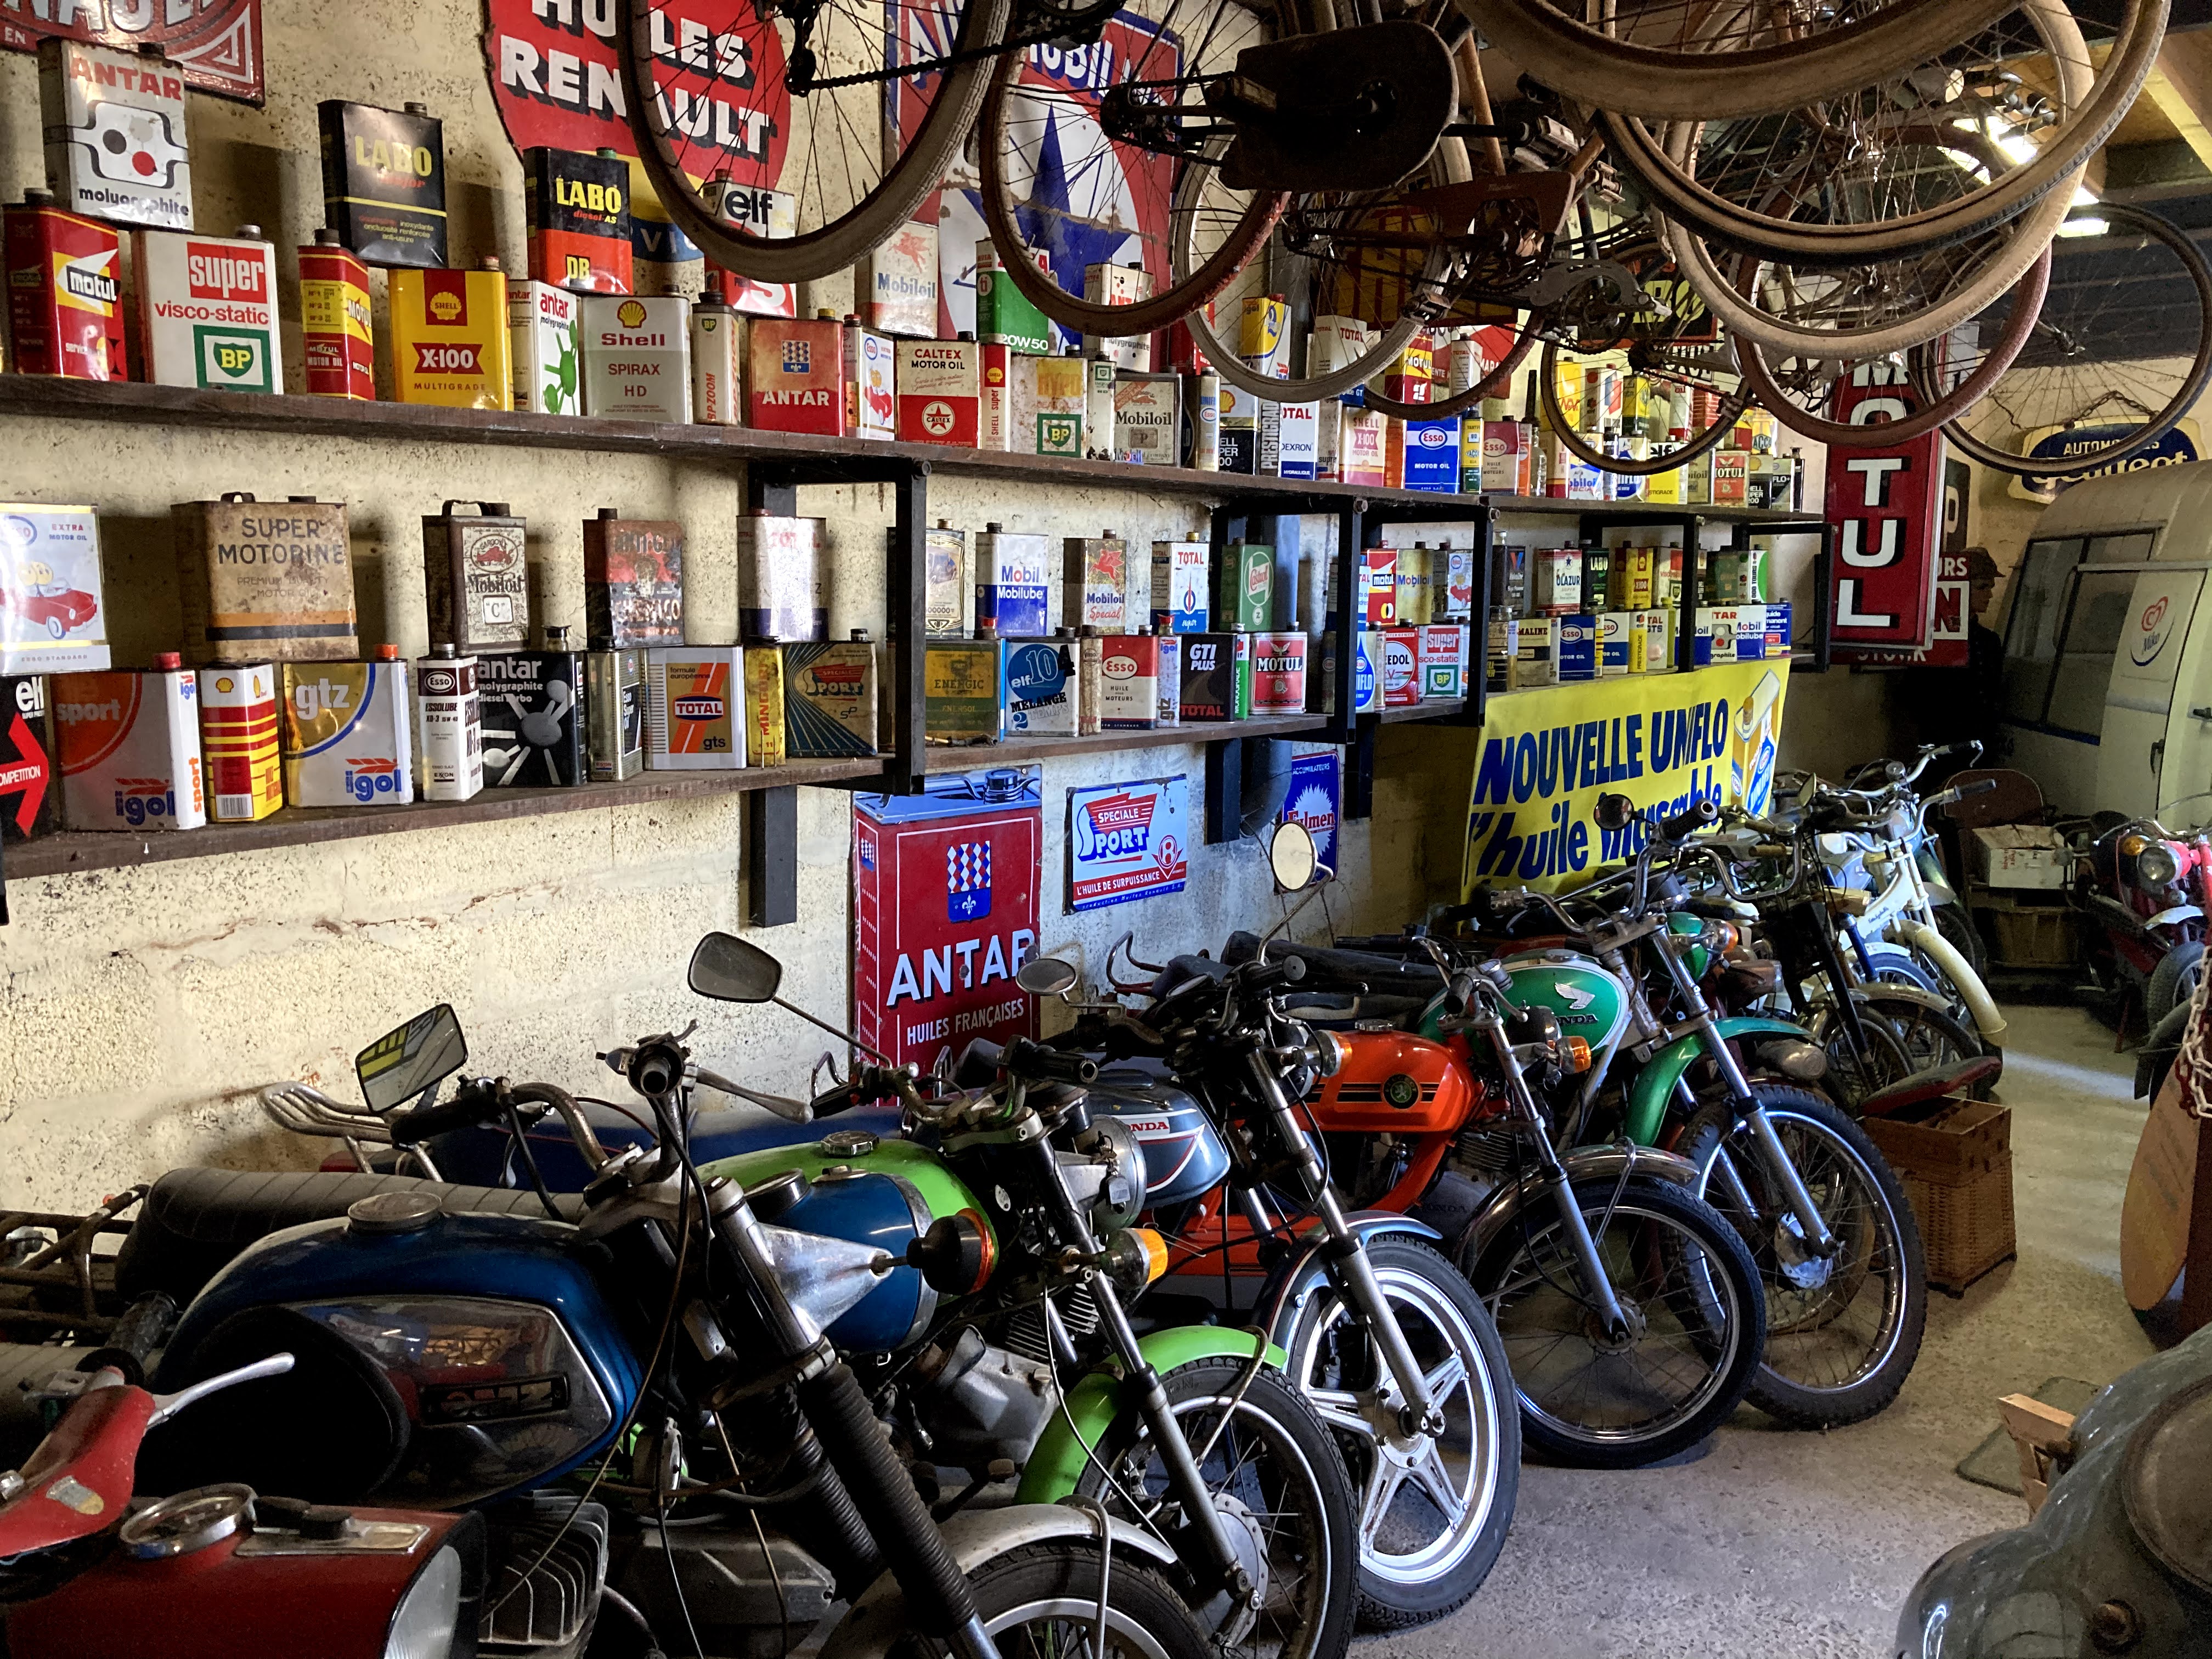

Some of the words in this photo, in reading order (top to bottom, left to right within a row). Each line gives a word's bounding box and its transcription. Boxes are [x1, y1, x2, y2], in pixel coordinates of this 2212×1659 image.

[69, 57, 182, 101] ANTAR
[354, 136, 432, 177] LABO
[556, 176, 621, 215] LABO
[725, 191, 772, 225] elf
[604, 215, 617, 225] AS
[566, 255, 590, 281] DB
[189, 255, 264, 299] super
[69, 271, 117, 302] motul
[878, 272, 936, 299] Mobiloil
[154, 300, 269, 325] visco-static
[348, 299, 371, 327] MOTUL
[435, 301, 459, 310] SHELL
[540, 292, 569, 320] antar
[540, 315, 569, 331] molygraphite
[704, 319, 715, 329] BP
[601, 332, 665, 347] Shell
[1340, 327, 1364, 342] TOTAL
[1002, 335, 1048, 351] 20W50
[220, 348, 251, 369] BP
[308, 356, 330, 366] MOTOR
[332, 357, 343, 366] OIL
[421, 348, 474, 369] X-100
[915, 348, 962, 359] CALTEX
[608, 363, 661, 376] SPIRAX
[911, 360, 948, 369] MOTOR
[950, 361, 966, 370] OIL
[1408, 358, 1432, 369] MOTUL
[414, 382, 486, 391] MULTIGRADE
[762, 390, 830, 406] ANTAR
[991, 389, 1000, 410] super
[991, 415, 1000, 436] SHELL
[1115, 411, 1172, 426] Mobiloil
[1353, 417, 1380, 428] SHELL
[1051, 427, 1070, 442] BP
[51, 523, 83, 532] EXTRA
[241, 518, 320, 538] SUPER
[219, 544, 345, 565] MOTORINE
[1178, 551, 1205, 566] TOTAL
[237, 576, 283, 586] PREMIUM
[1001, 565, 1040, 583] Mobil
[1250, 566, 1269, 590] Castrol
[1373, 575, 1394, 586] motul
[1397, 574, 1433, 588] Mobiloil
[1556, 575, 1581, 586] OLAZUR
[467, 573, 526, 594] Mobiloil
[998, 586, 1043, 600] Mobilube
[1087, 592, 1125, 605] Mobiloil
[1089, 606, 1122, 621] Special
[1182, 619, 1197, 630] super
[1160, 643, 1178, 654] igol
[1427, 633, 1459, 652] super
[2142, 631, 2160, 654] Miko
[1189, 644, 1217, 661] GTI
[478, 656, 543, 680] antar
[1190, 660, 1216, 671] PLUS
[1256, 657, 1303, 673] MOTUL
[805, 668, 865, 696] SPORT
[934, 679, 984, 690] ENERGIC
[1011, 674, 1032, 689] elf
[1436, 674, 1449, 685] BP
[295, 678, 351, 721] gtz
[478, 693, 504, 703] diesel
[1009, 692, 1067, 713] MELANGE
[55, 699, 121, 726] sport
[425, 702, 458, 712] ESSOLUBE
[676, 703, 723, 714] TOTAL
[1028, 702, 1069, 720] TEMPS
[1180, 704, 1224, 716] TOTAL
[703, 736, 726, 751] gts
[1473, 713, 1644, 805] NOUVELLE
[1292, 762, 1330, 775] ACCUMULATEURS
[188, 757, 203, 813] sport
[345, 769, 403, 802] igol
[114, 790, 176, 826] igol
[1098, 807, 1139, 823] SPECIALE
[1286, 809, 1336, 828] Fulmen
[1077, 803, 1150, 862] SPORT
[1076, 882, 1101, 896] L'HUILE
[1102, 881, 1111, 891] DE
[1112, 871, 1160, 889] SURPUISSANCE
[885, 928, 1038, 1007] ANTAR
[906, 1017, 950, 1046] HUILES
[955, 998, 1025, 1035] FRANÇAISES
